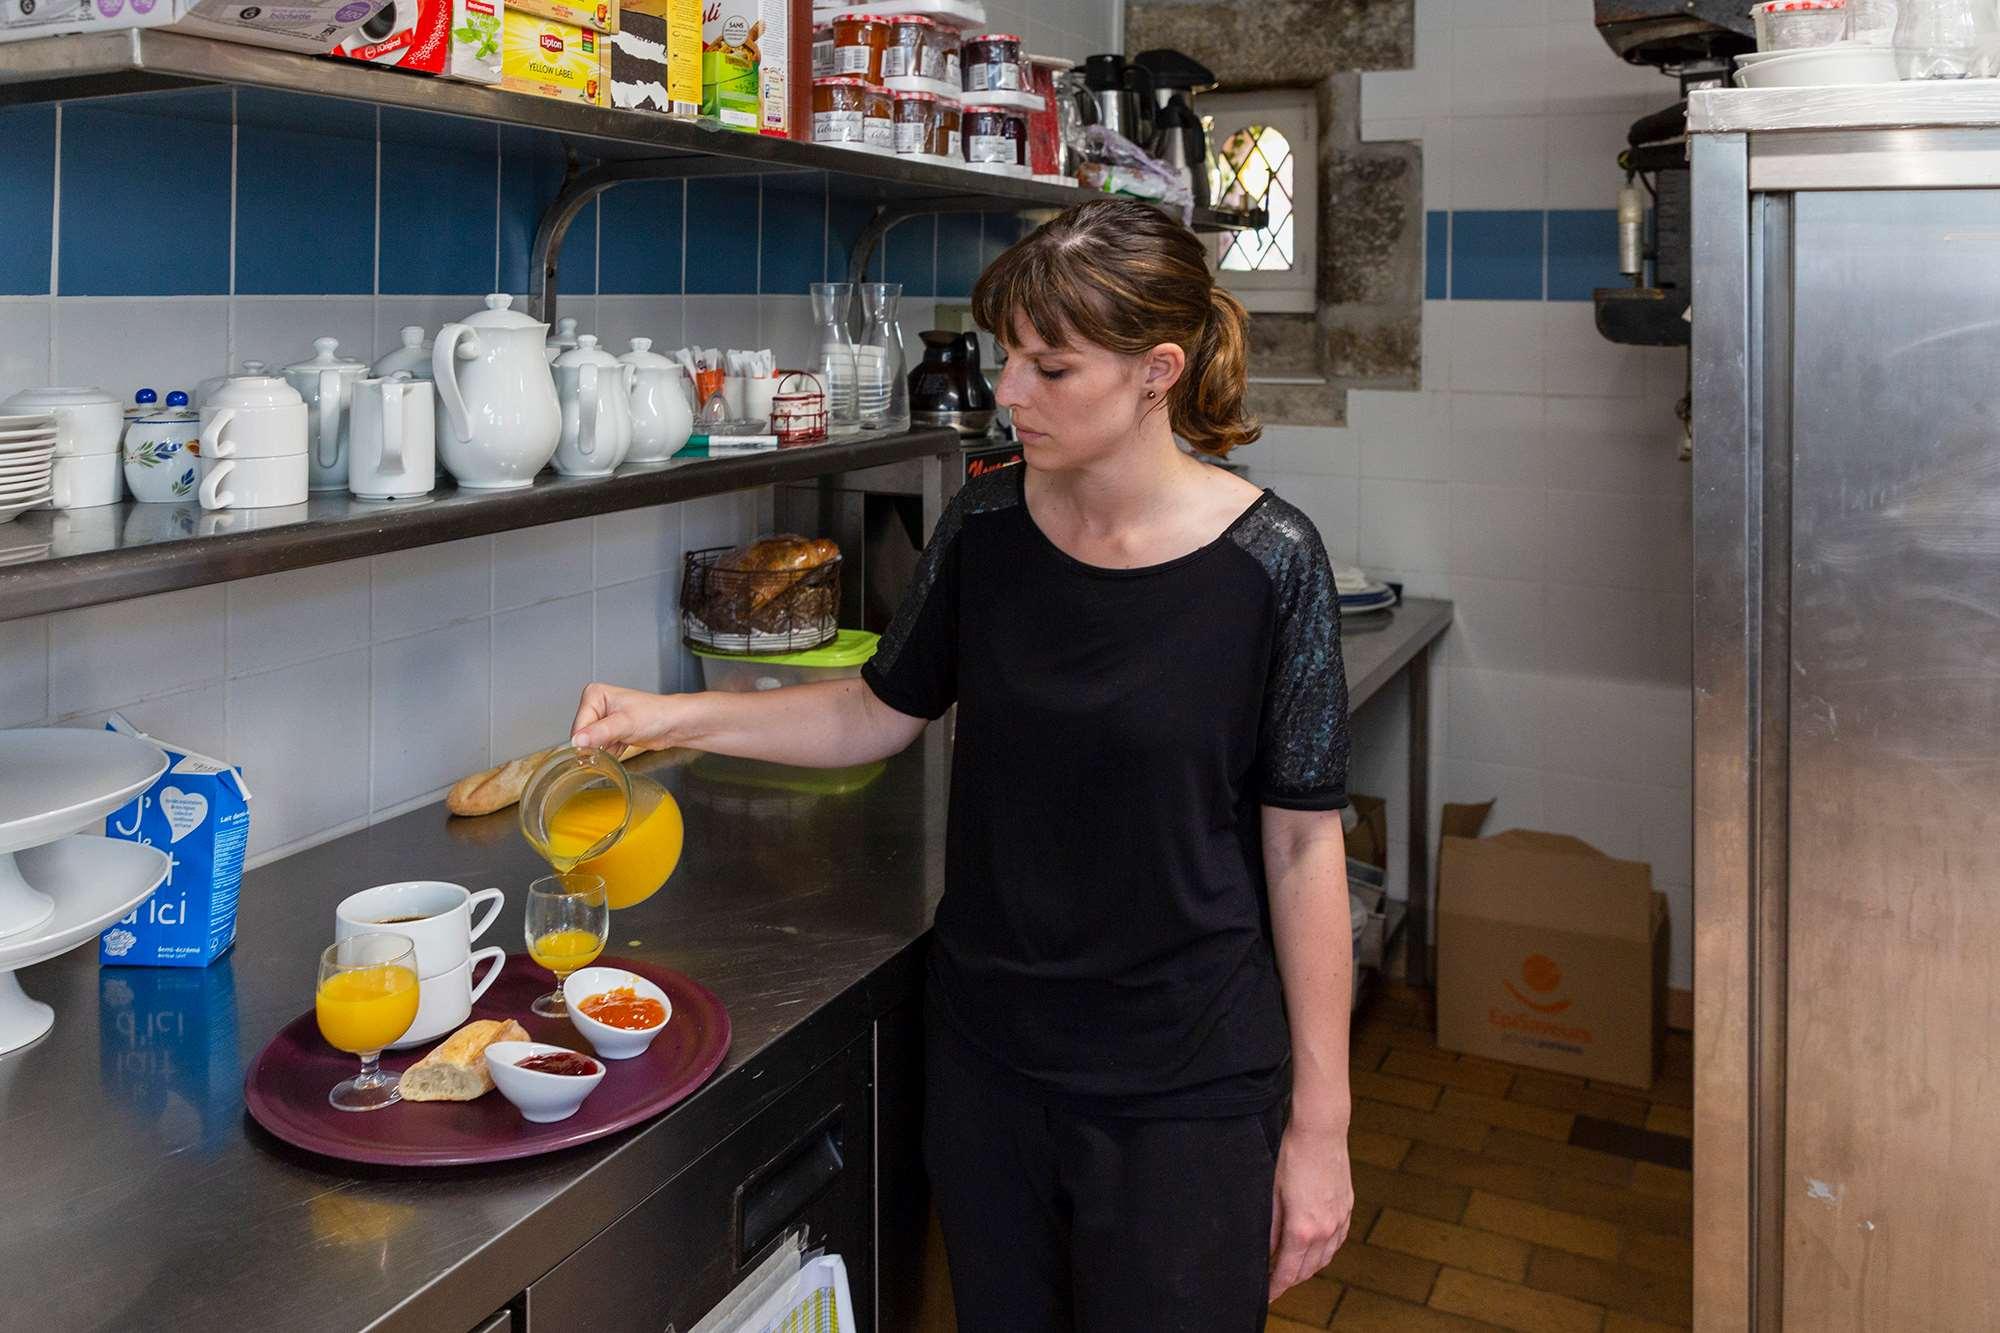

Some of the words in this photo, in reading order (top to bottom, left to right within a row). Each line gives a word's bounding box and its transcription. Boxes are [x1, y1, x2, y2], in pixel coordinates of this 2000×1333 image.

[541, 36, 562, 49] Lipton
[528, 63, 554, 75] YELLOW
[555, 67, 575, 80] LABEL
